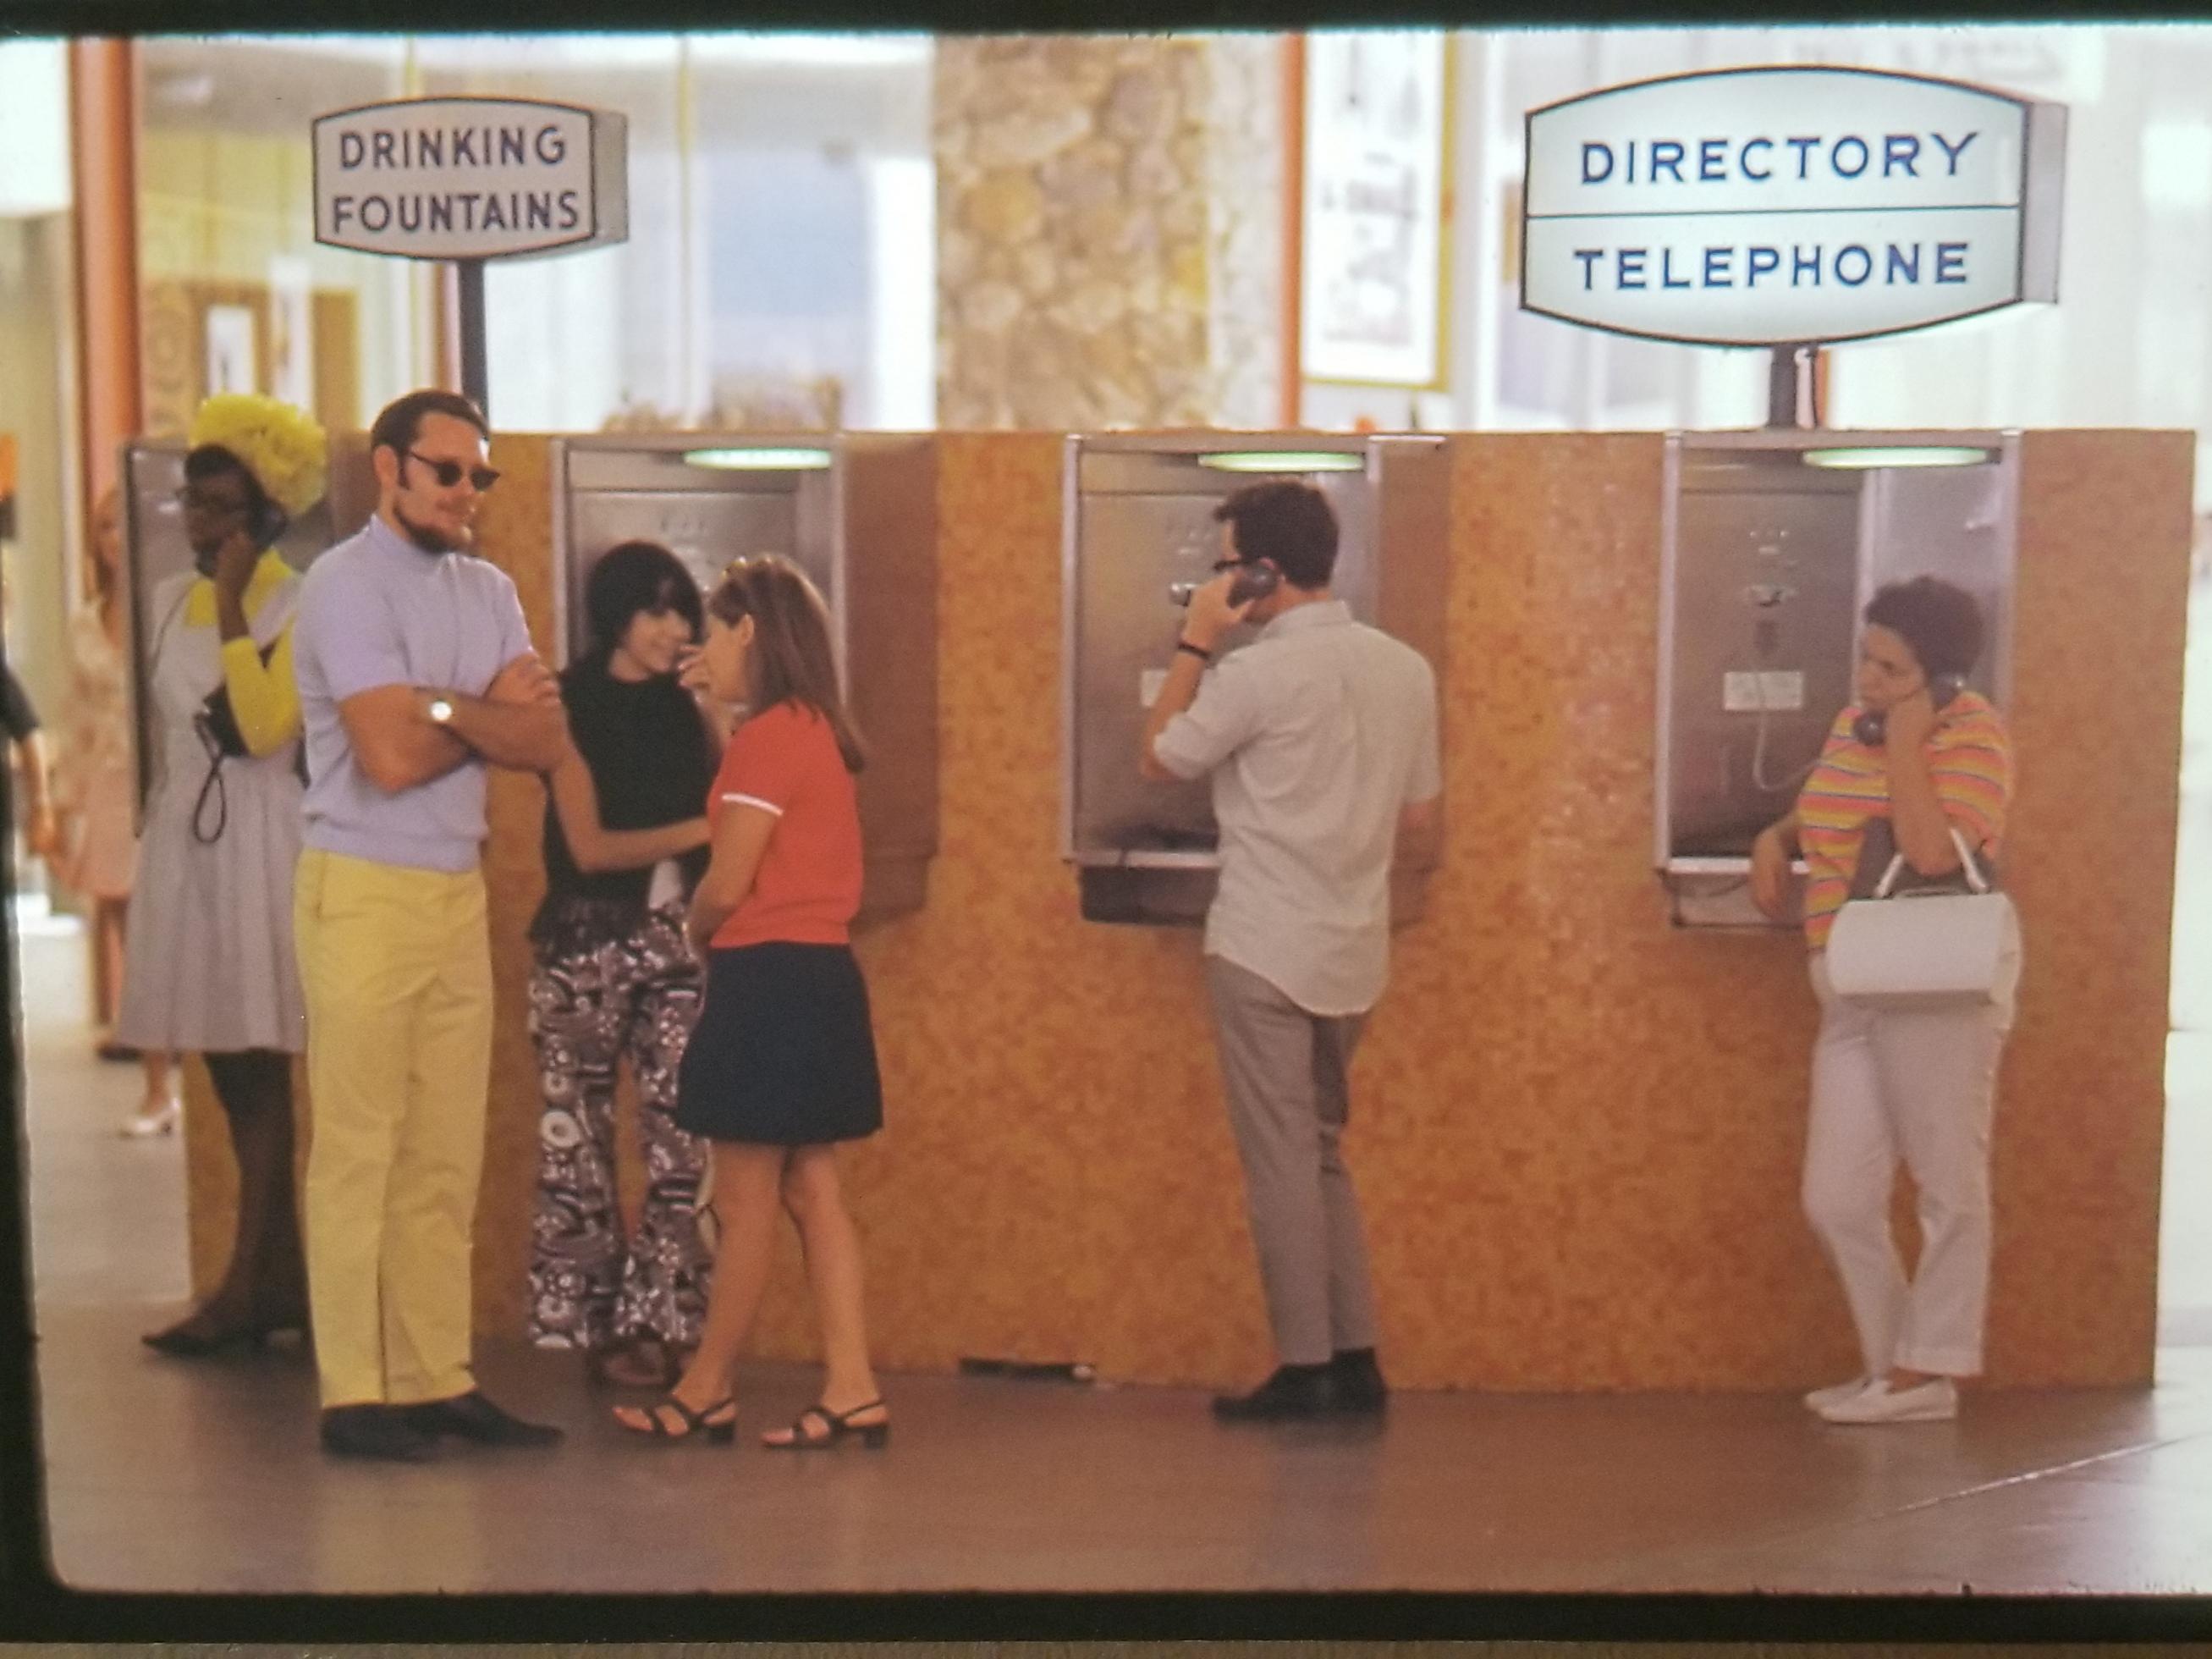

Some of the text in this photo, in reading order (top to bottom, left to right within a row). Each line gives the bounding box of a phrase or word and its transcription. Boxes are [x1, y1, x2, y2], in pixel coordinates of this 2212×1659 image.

[340, 125, 564, 168] DRINKING
[1581, 131, 1979, 185] DIRECTORY
[332, 190, 578, 233] FOUNTAINS
[1573, 242, 1969, 290] TELEPHONE
